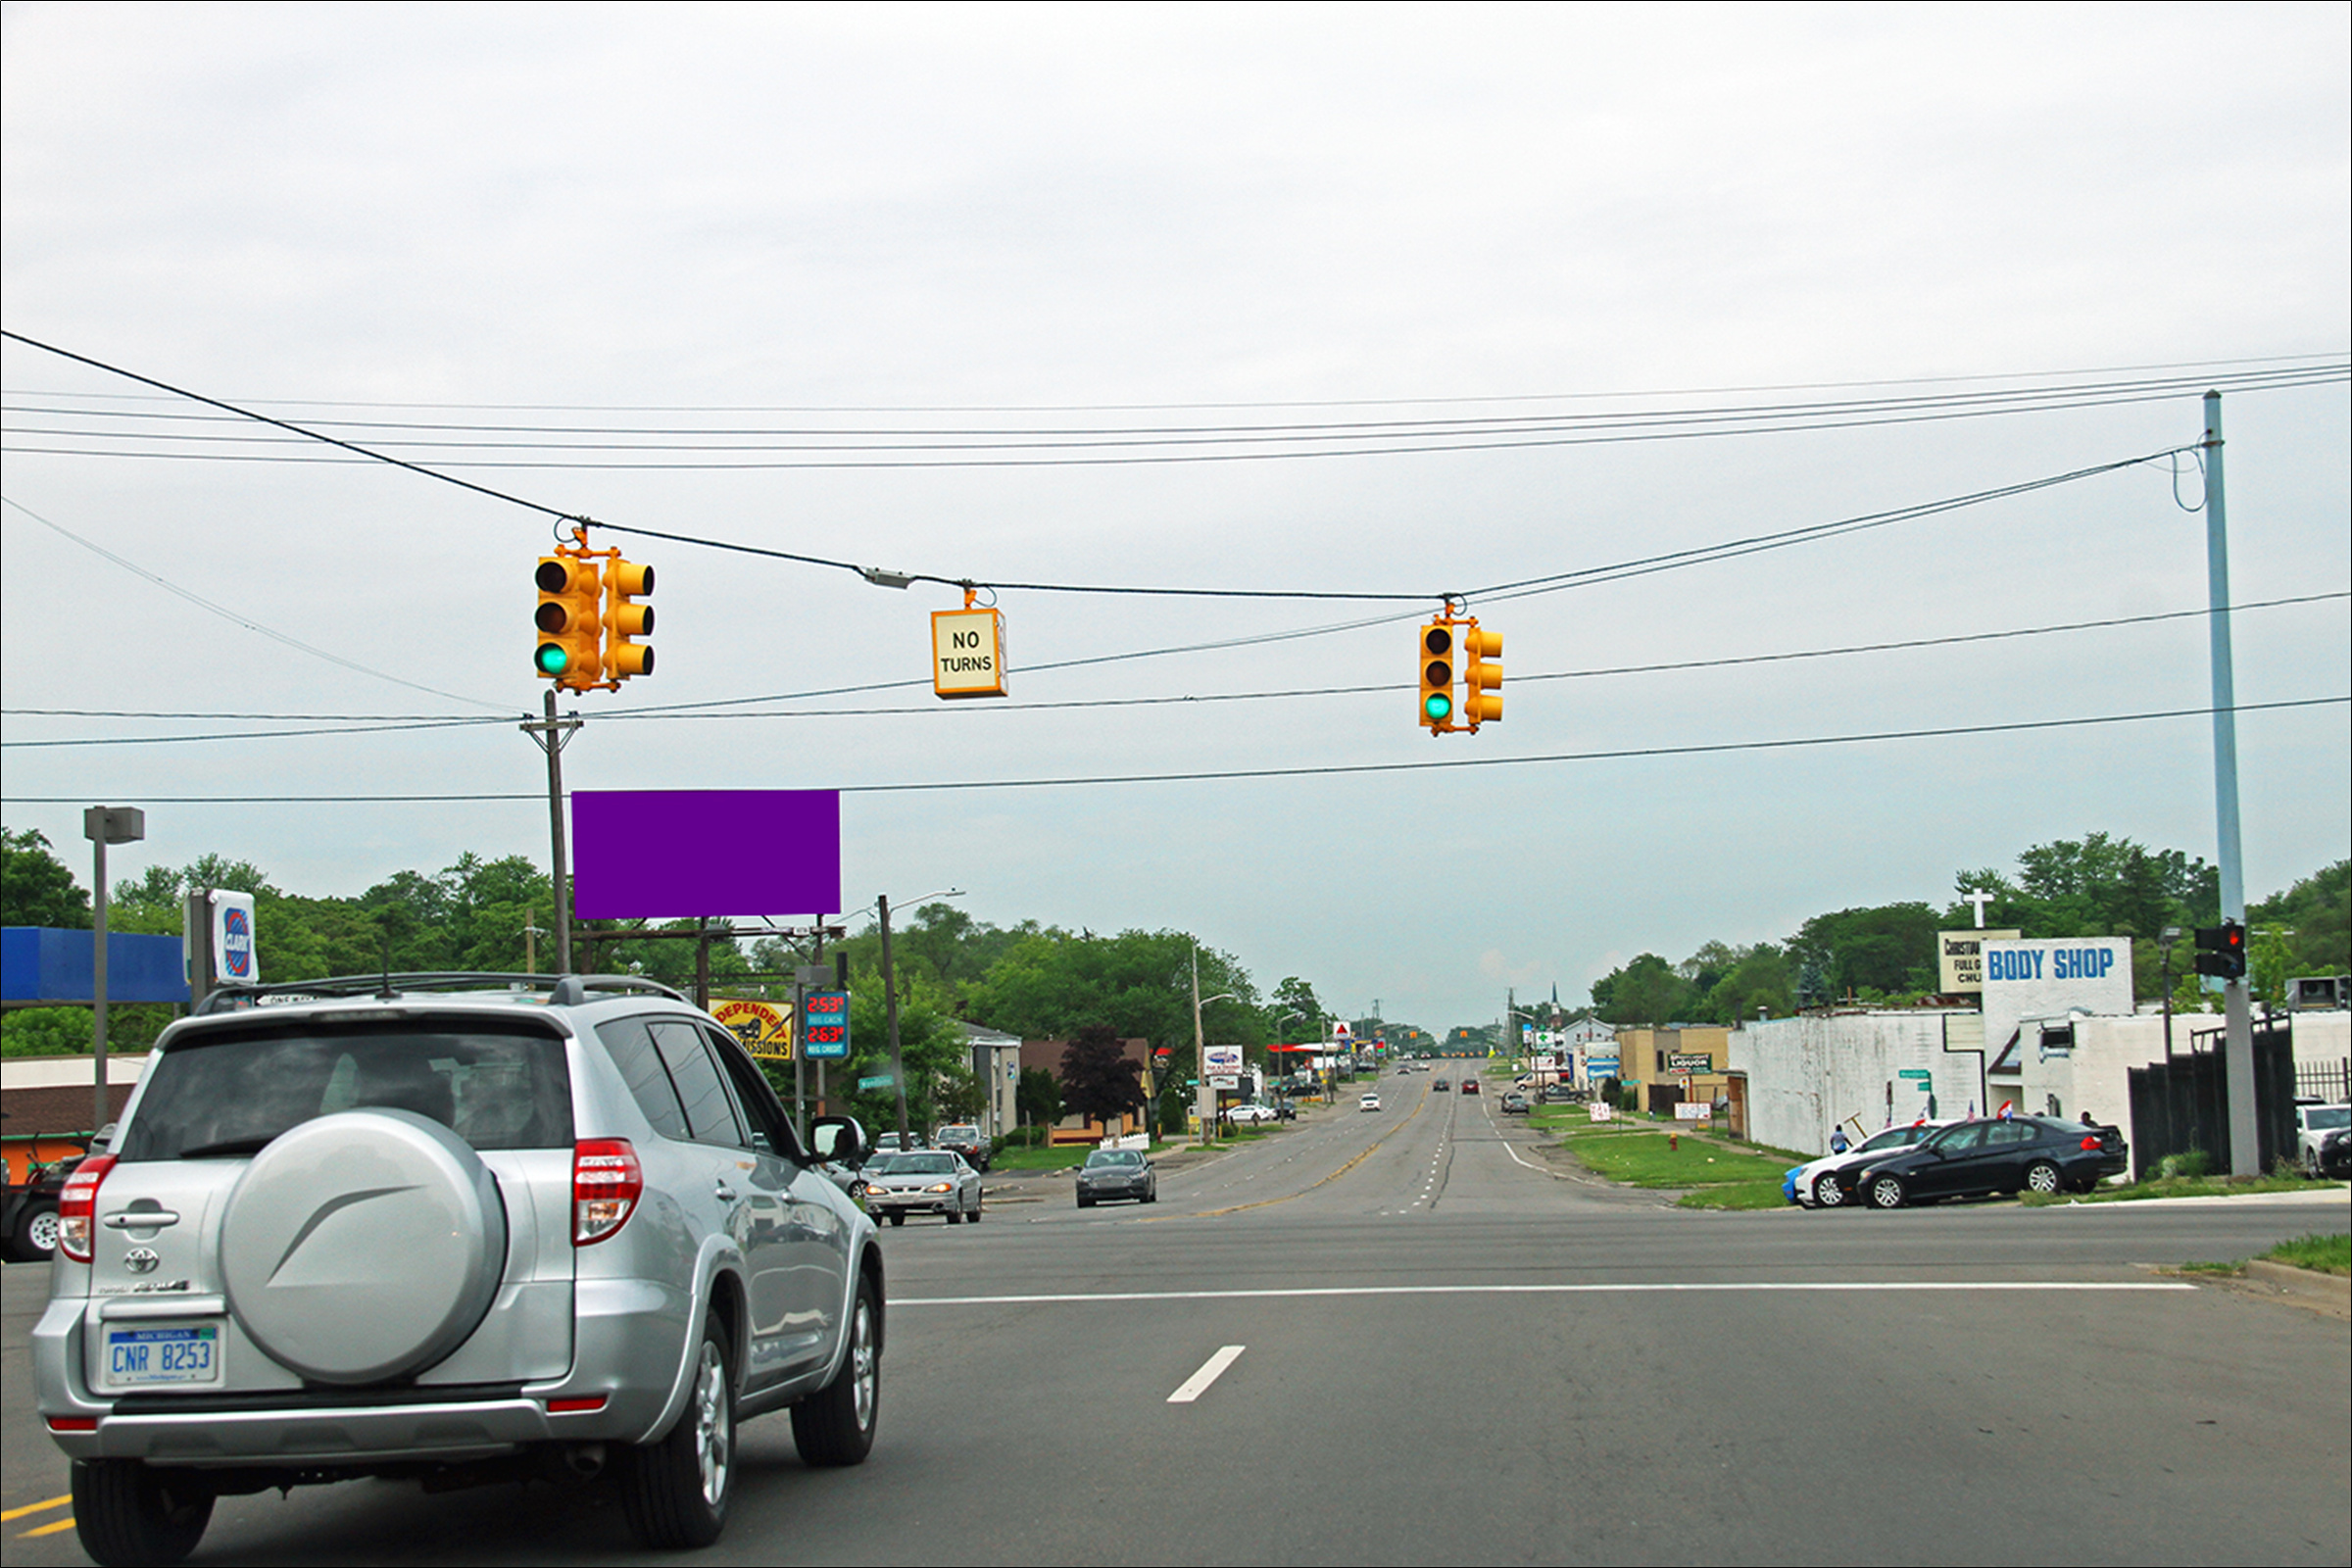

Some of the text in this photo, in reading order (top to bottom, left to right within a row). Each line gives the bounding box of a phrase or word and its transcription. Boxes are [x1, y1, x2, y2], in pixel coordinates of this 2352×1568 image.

[953, 631, 980, 650] NO
[941, 656, 993, 672] TURNS
[225, 933, 250, 953] CLARK
[1954, 959, 1973, 970] FULL
[1987, 948, 2114, 981] BODY SHOP
[1957, 973, 1982, 983] CHU
[135, 1330, 191, 1341] MICHIGAN
[112, 1342, 211, 1373] CNR 8253
